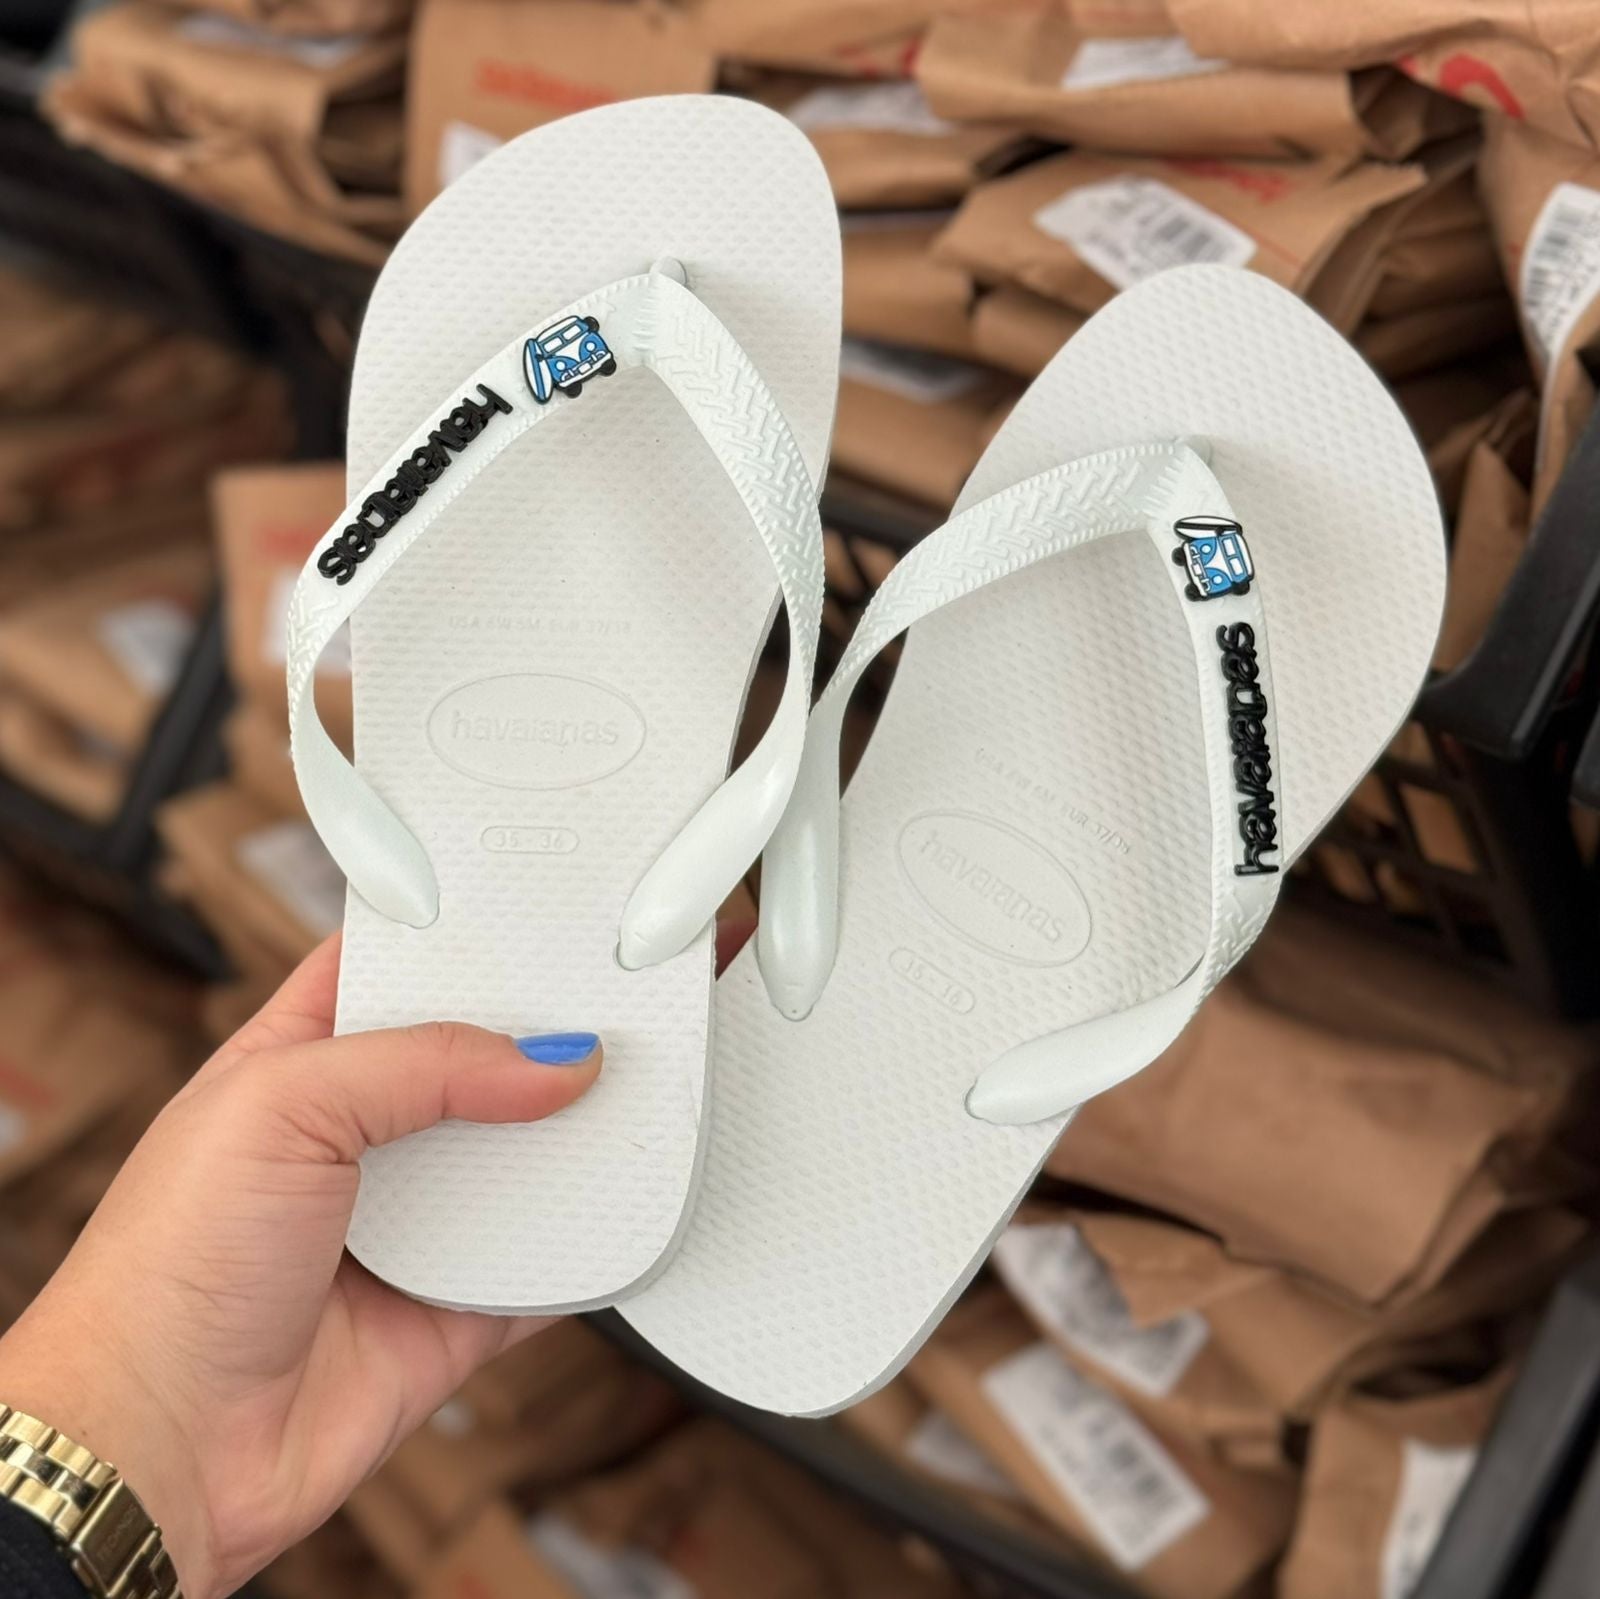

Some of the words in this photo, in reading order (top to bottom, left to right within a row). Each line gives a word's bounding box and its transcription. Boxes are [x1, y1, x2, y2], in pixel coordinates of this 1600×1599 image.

[317, 384, 513, 586] havaianas
[448, 614, 480, 630] USA
[451, 709, 619, 747] havaianas
[1216, 621, 1279, 877] havaianas
[493, 830, 519, 849] 35
[919, 829, 1067, 944] havaianas
